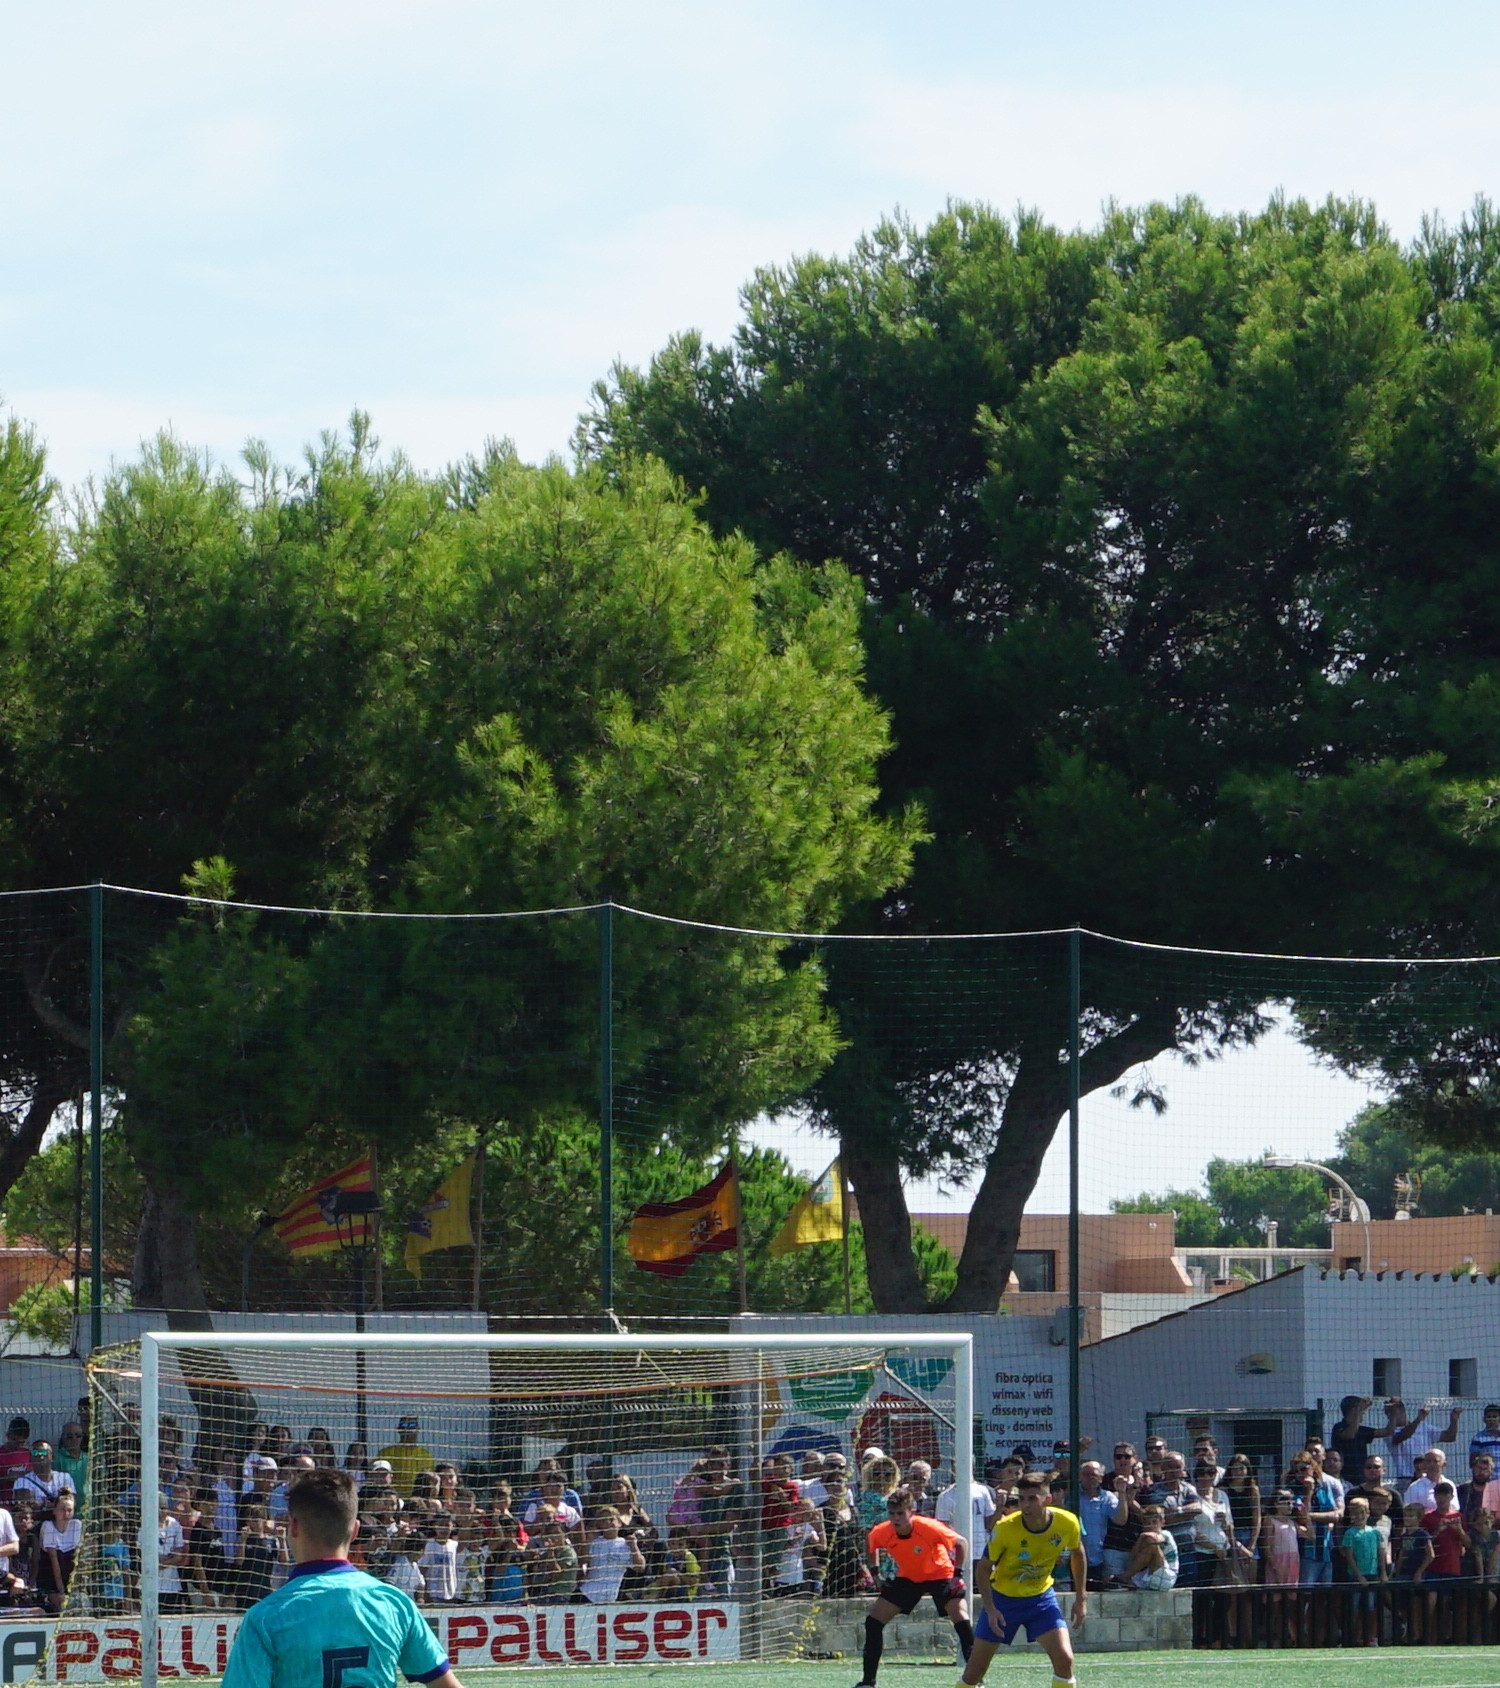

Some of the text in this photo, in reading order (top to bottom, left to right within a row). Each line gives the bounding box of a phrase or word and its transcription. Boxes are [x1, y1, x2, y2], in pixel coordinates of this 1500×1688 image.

[995, 1372, 1020, 1384] fibra
[992, 1388, 1053, 1400] wimax wifi
[991, 1404, 1053, 1418] disseny web
[985, 1421, 1005, 1435] ting
[446, 1608, 729, 1665] Palliser
